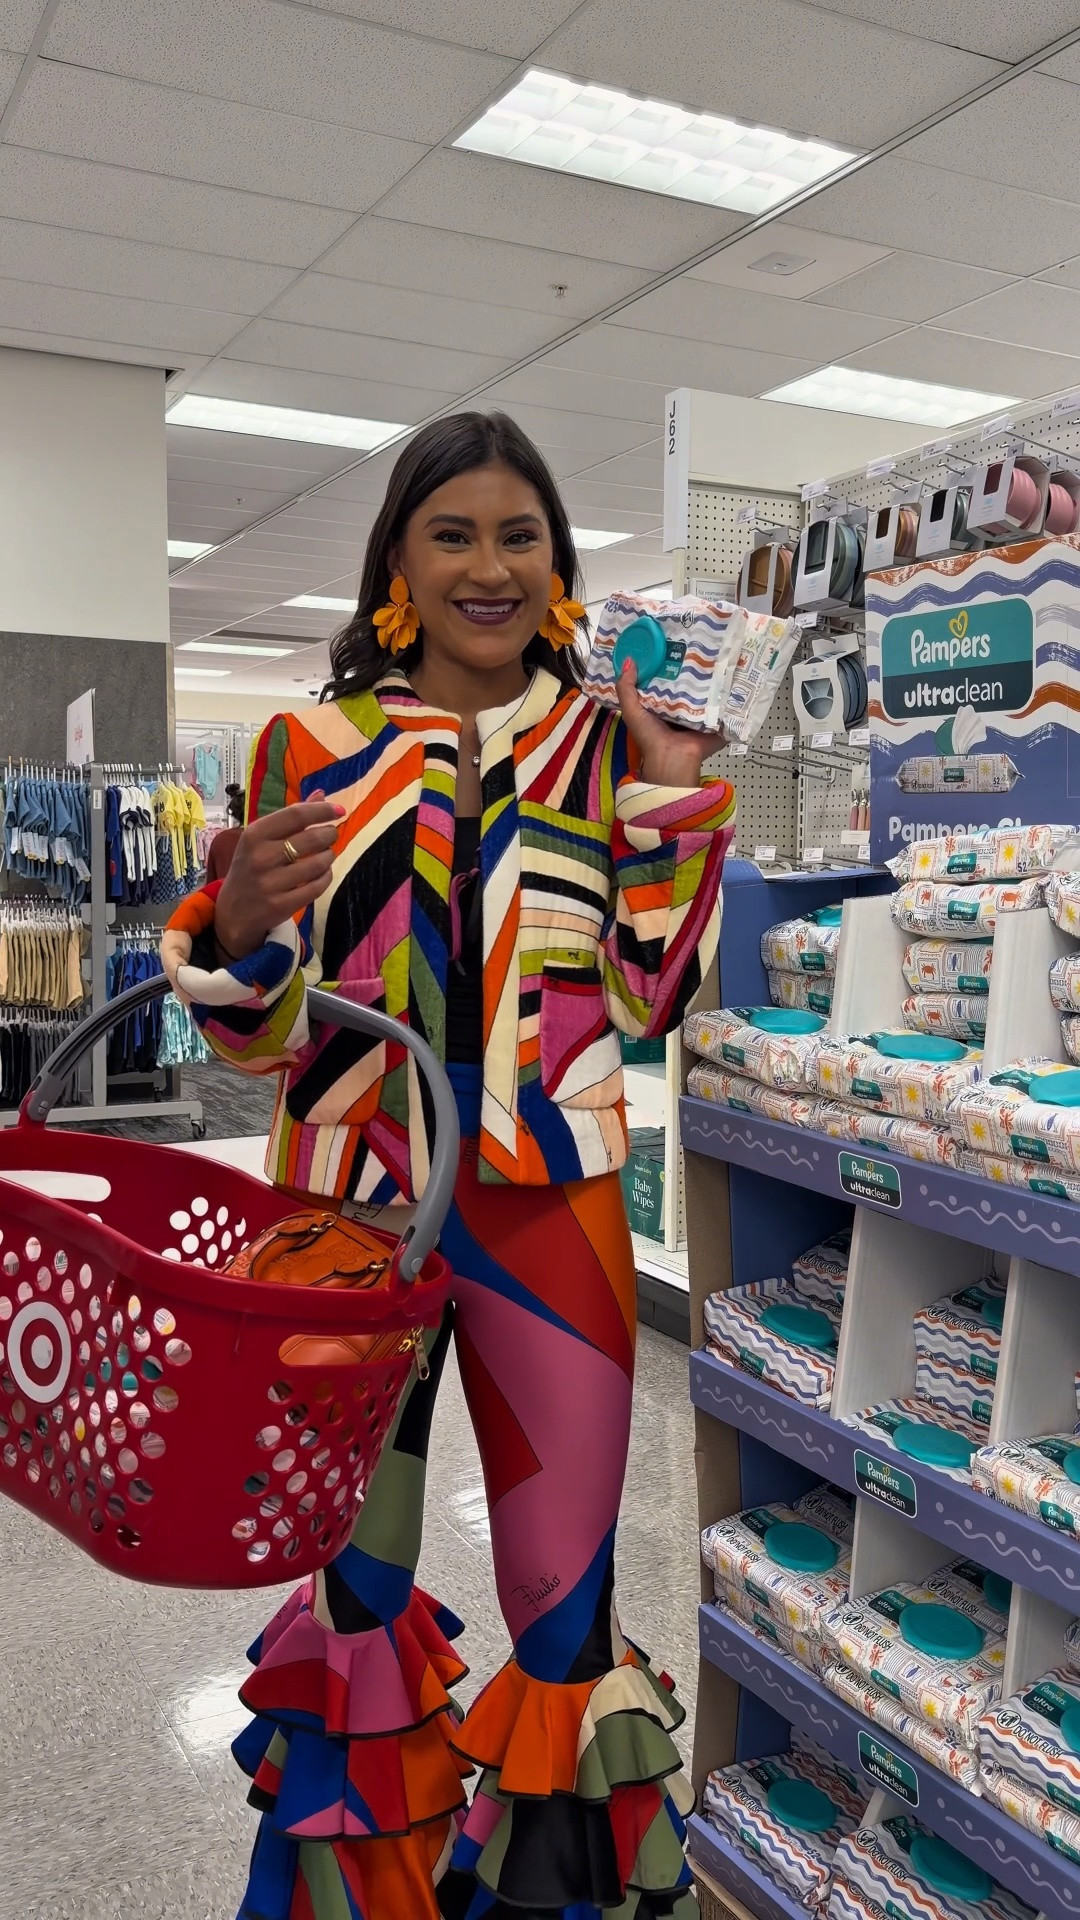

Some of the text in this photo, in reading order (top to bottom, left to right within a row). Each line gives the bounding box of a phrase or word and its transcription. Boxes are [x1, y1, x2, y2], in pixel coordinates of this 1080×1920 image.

[911, 629, 991, 667] Pampers
[904, 678, 1003, 708] ultraclean
[1018, 862, 1027, 872] 52
[925, 1108, 932, 1120] 52
[851, 1161, 884, 1184] Pampers
[634, 1177, 652, 1197] Baby
[850, 1182, 890, 1201] ultraclean
[632, 1190, 654, 1208] Wipes
[867, 1461, 899, 1490] Pampers
[866, 1481, 905, 1509] ultraclean
[877, 1599, 894, 1612] ultra
[960, 1601, 979, 1615] FLUSH
[854, 1623, 894, 1651] DO NOT FLUSH
[866, 1685, 885, 1701] FLUSH
[1033, 1695, 1054, 1712] ultra
[1040, 1684, 1067, 1706] Pampers
[1013, 1725, 1063, 1759] DO NOT FLUSH
[871, 1744, 902, 1778] Pampers
[869, 1763, 908, 1797] ultraclean
[807, 1849, 821, 1859] 52
[868, 1846, 908, 1881] DO NOT FLUSH
